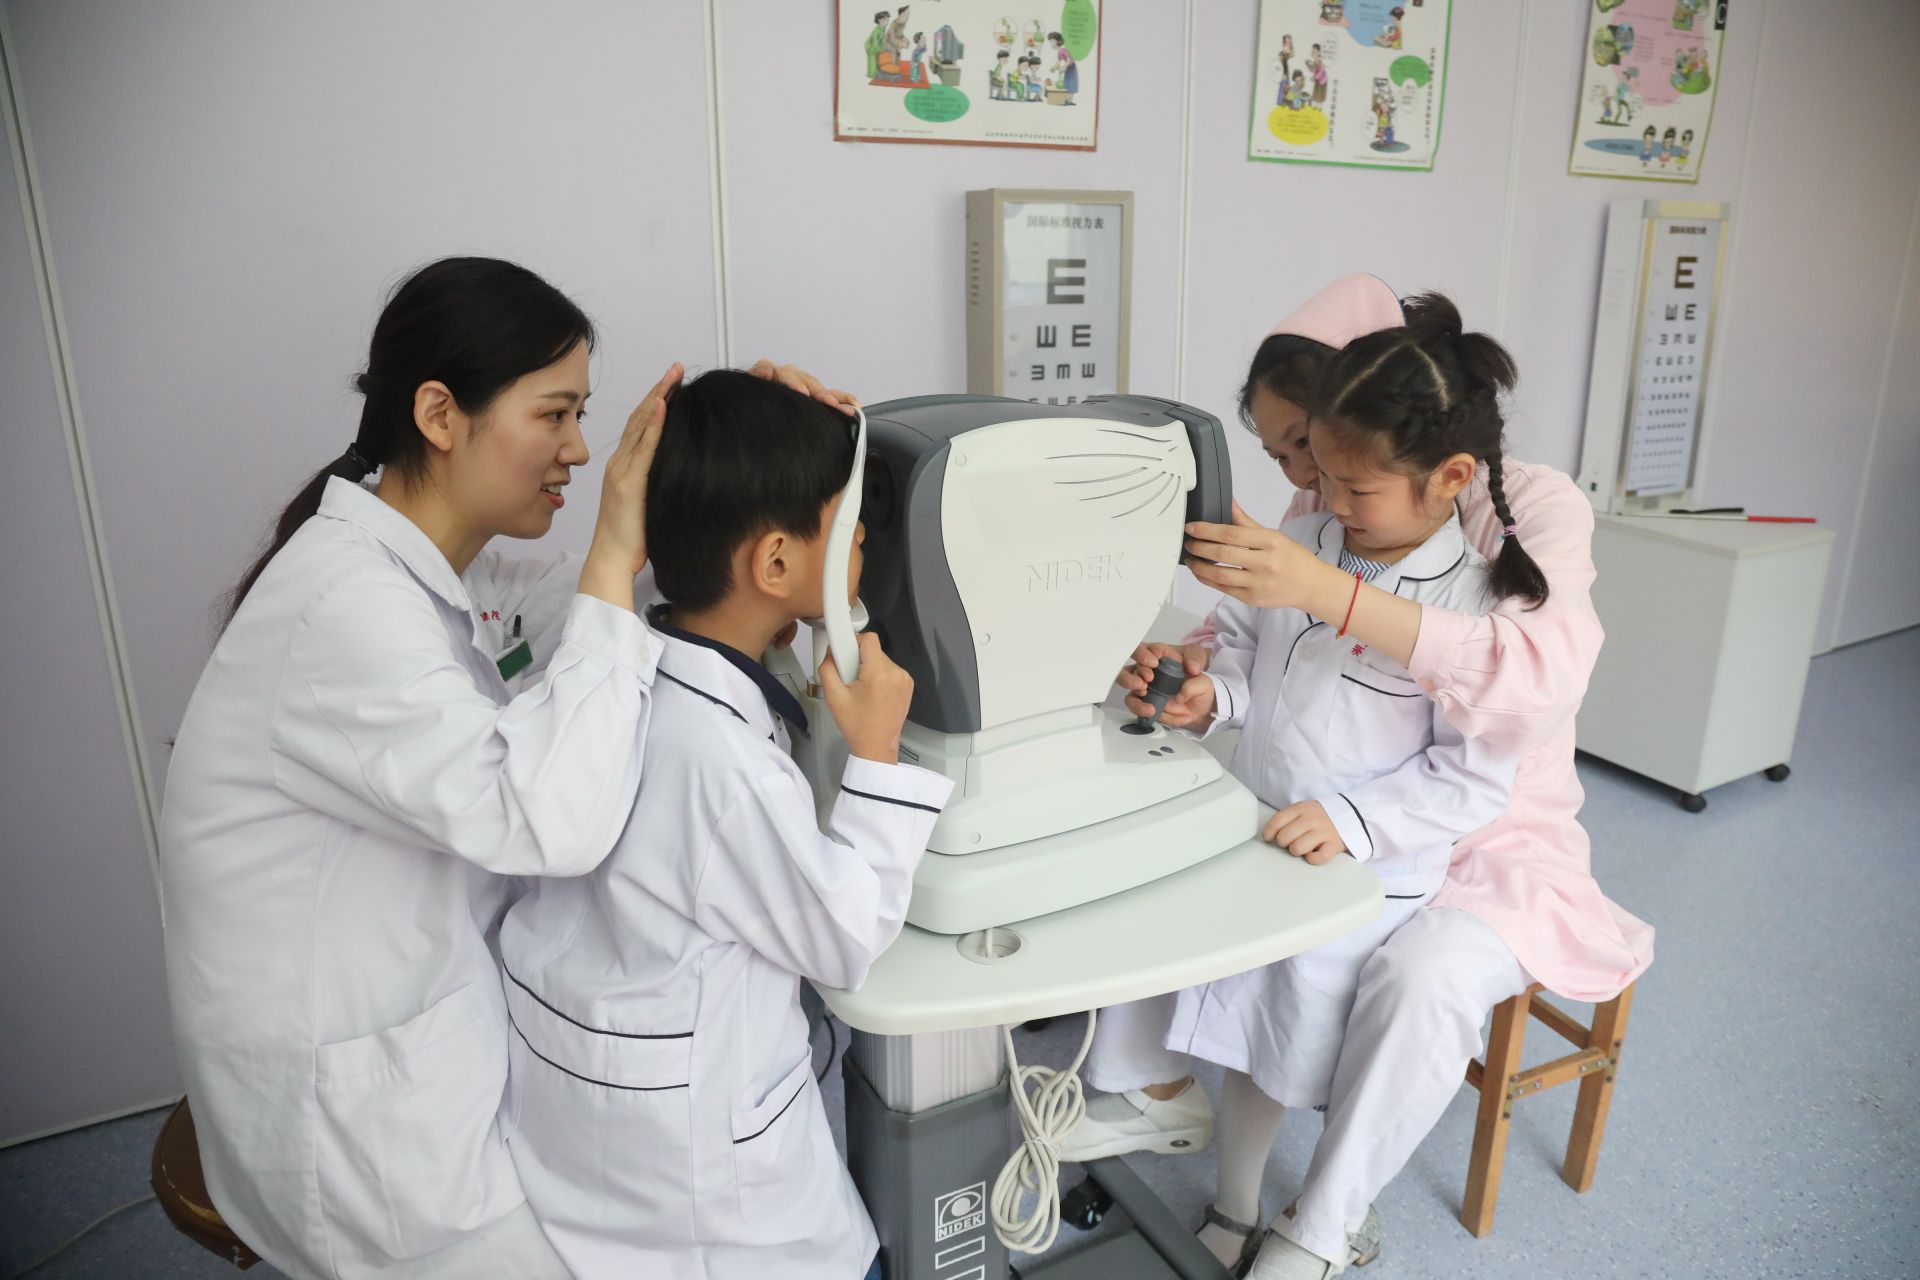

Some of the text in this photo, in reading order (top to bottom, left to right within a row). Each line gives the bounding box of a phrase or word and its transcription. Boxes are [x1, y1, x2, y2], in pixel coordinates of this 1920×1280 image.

[1027, 215, 1104, 229] 国际标准视力表
[1047, 259, 1086, 304] E
[1674, 256, 1698, 289] E
[1024, 551, 1125, 593] NIDEK
[938, 1214, 983, 1239] NIDEK
